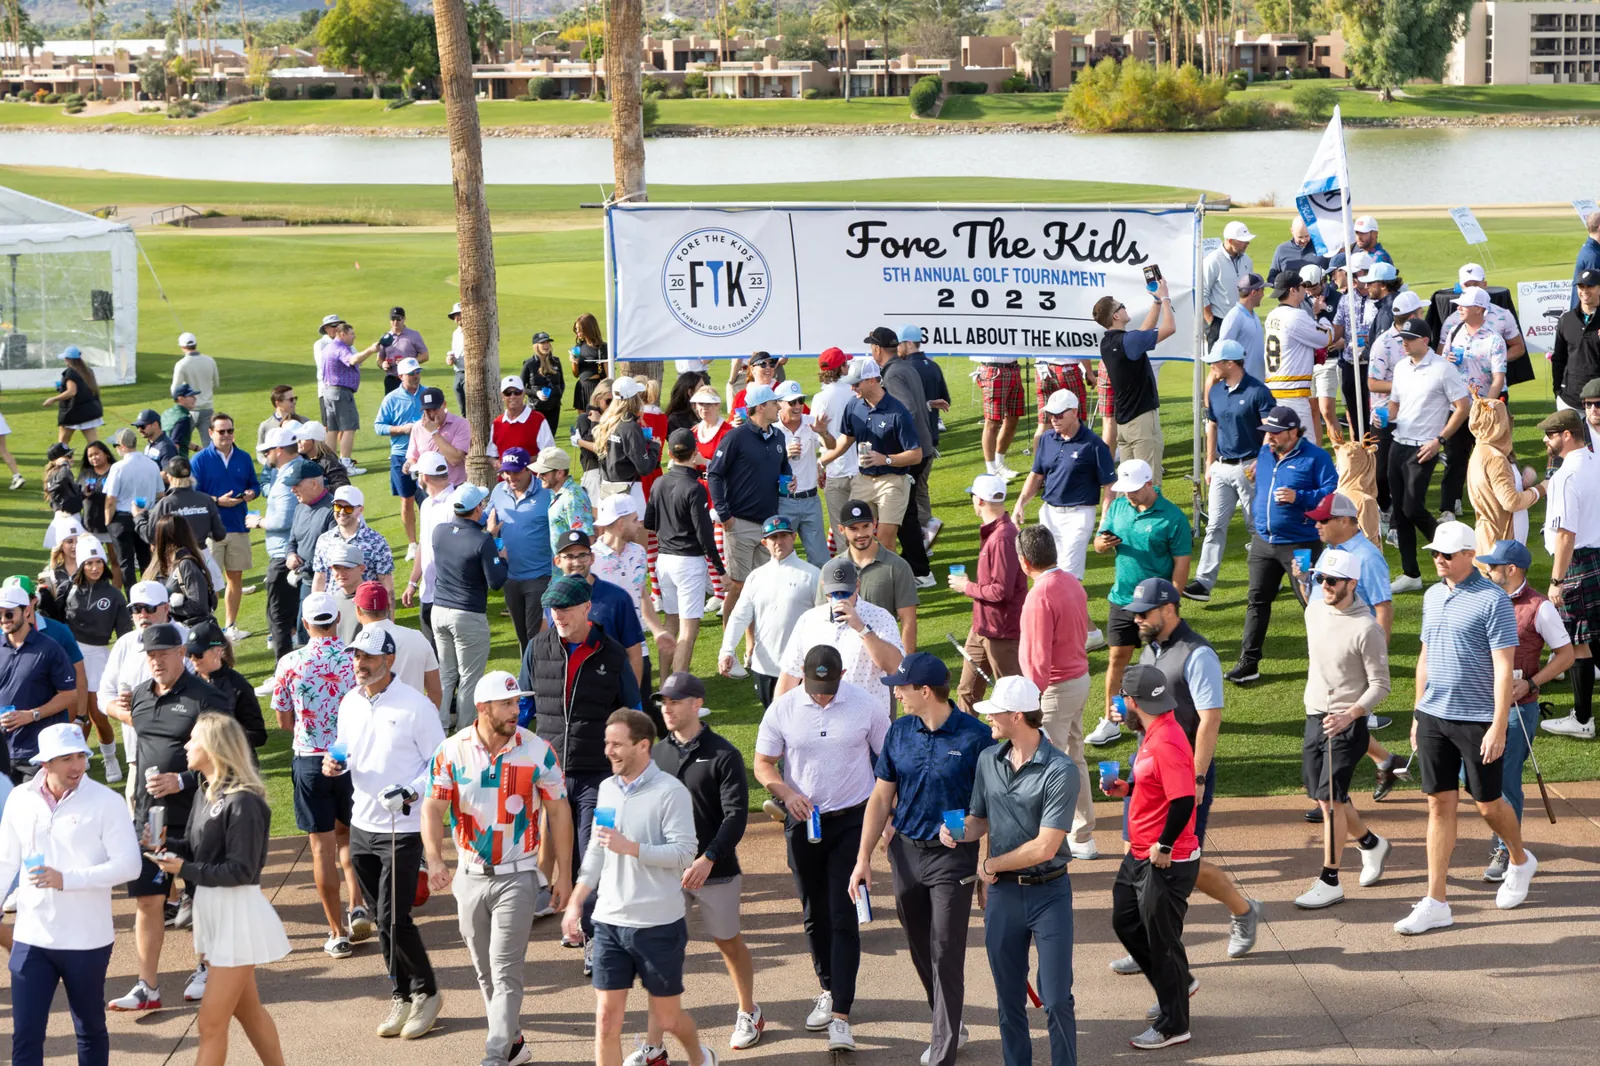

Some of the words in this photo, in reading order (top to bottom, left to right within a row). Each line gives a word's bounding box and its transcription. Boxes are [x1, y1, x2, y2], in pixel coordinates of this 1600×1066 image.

[676, 238, 701, 262] FORE
[704, 235, 726, 243] THE
[730, 239, 754, 262] KIDS
[846, 220, 947, 259] Fore
[952, 217, 1036, 259] The
[1043, 218, 1149, 266] Kids
[671, 278, 684, 287] 20
[750, 276, 763, 286] 23
[883, 267, 910, 282] 5TH
[914, 267, 970, 282] ANNUAL
[973, 267, 1009, 283] GOLF
[1012, 267, 1107, 288] TOURNAMENT
[681, 312, 706, 329] ANNUAL
[728, 297, 763, 330] TOURNAMENT
[933, 327, 962, 345] ALL
[966, 328, 1018, 346] ABOUT
[1021, 329, 1051, 347] THE
[1055, 331, 1099, 348] KIDS!
